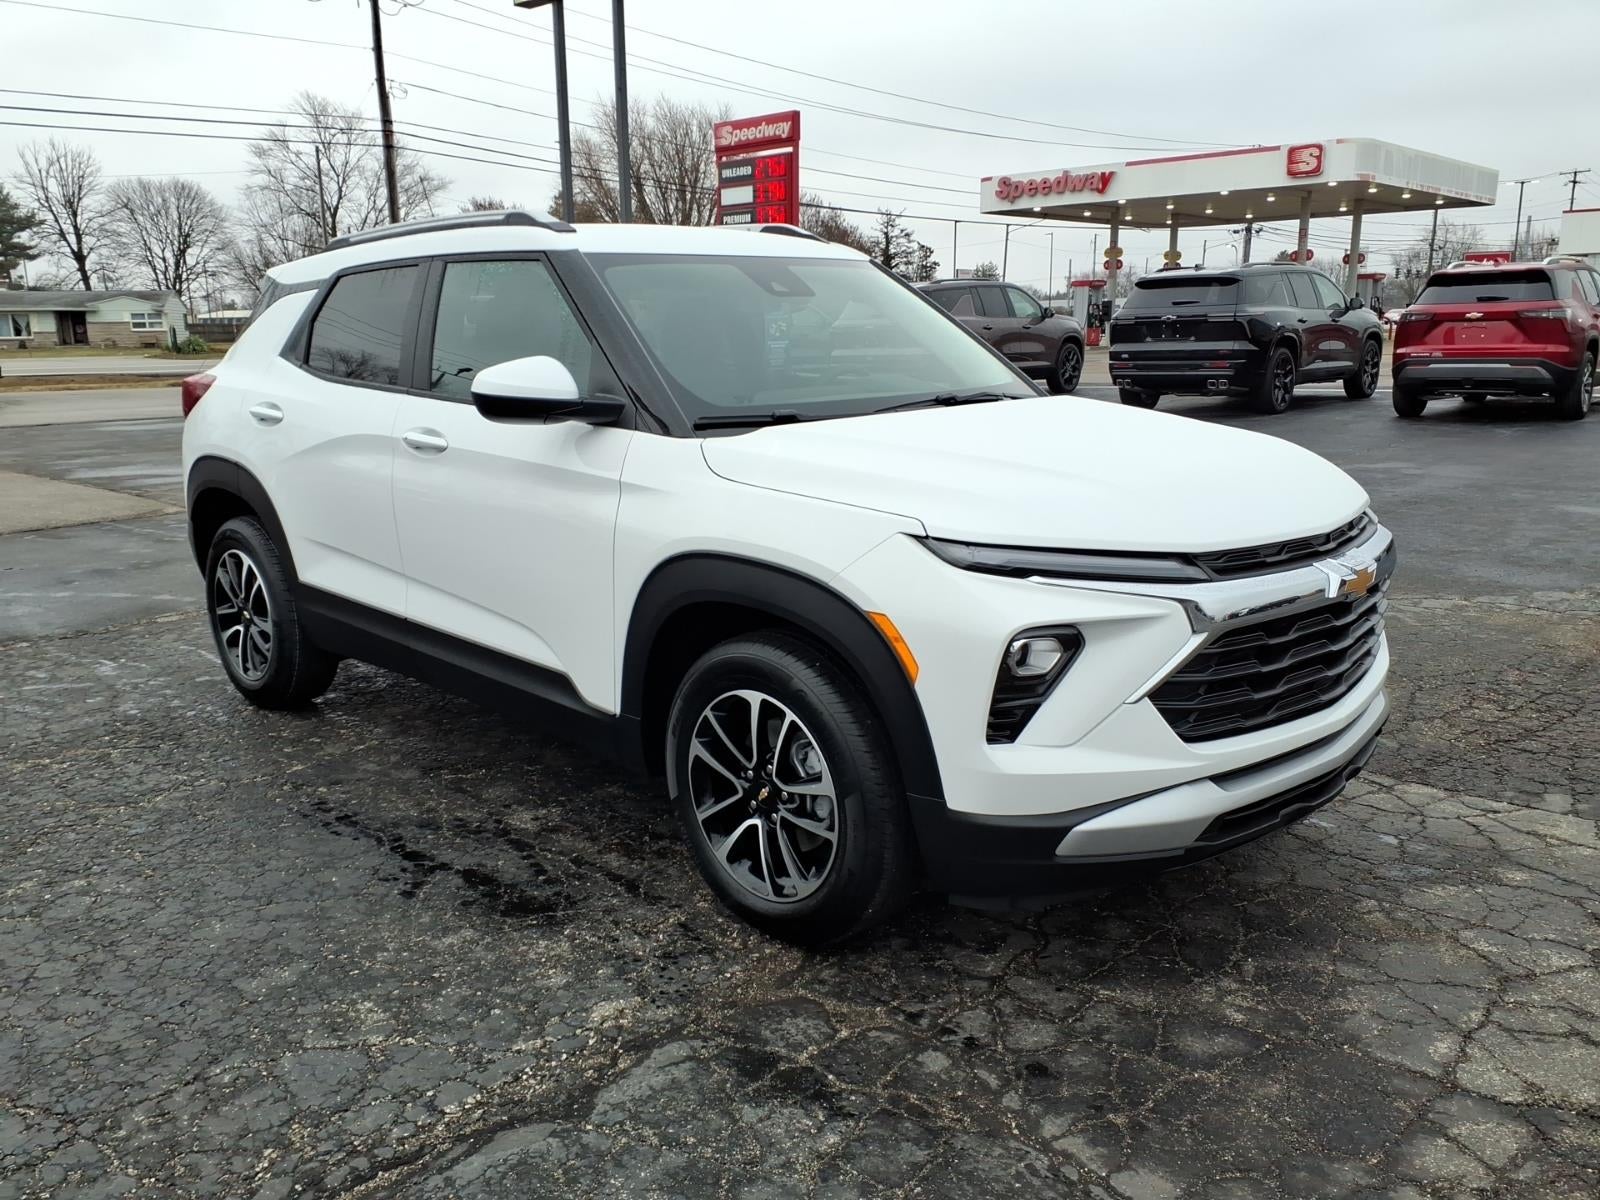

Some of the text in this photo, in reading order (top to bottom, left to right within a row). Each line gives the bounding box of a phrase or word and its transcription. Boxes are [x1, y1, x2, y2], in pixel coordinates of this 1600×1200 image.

[719, 121, 792, 145] Speedway
[721, 165, 752, 178] UNLEADED
[995, 170, 1117, 204] Speedway
[723, 213, 751, 224] PREMIUM
